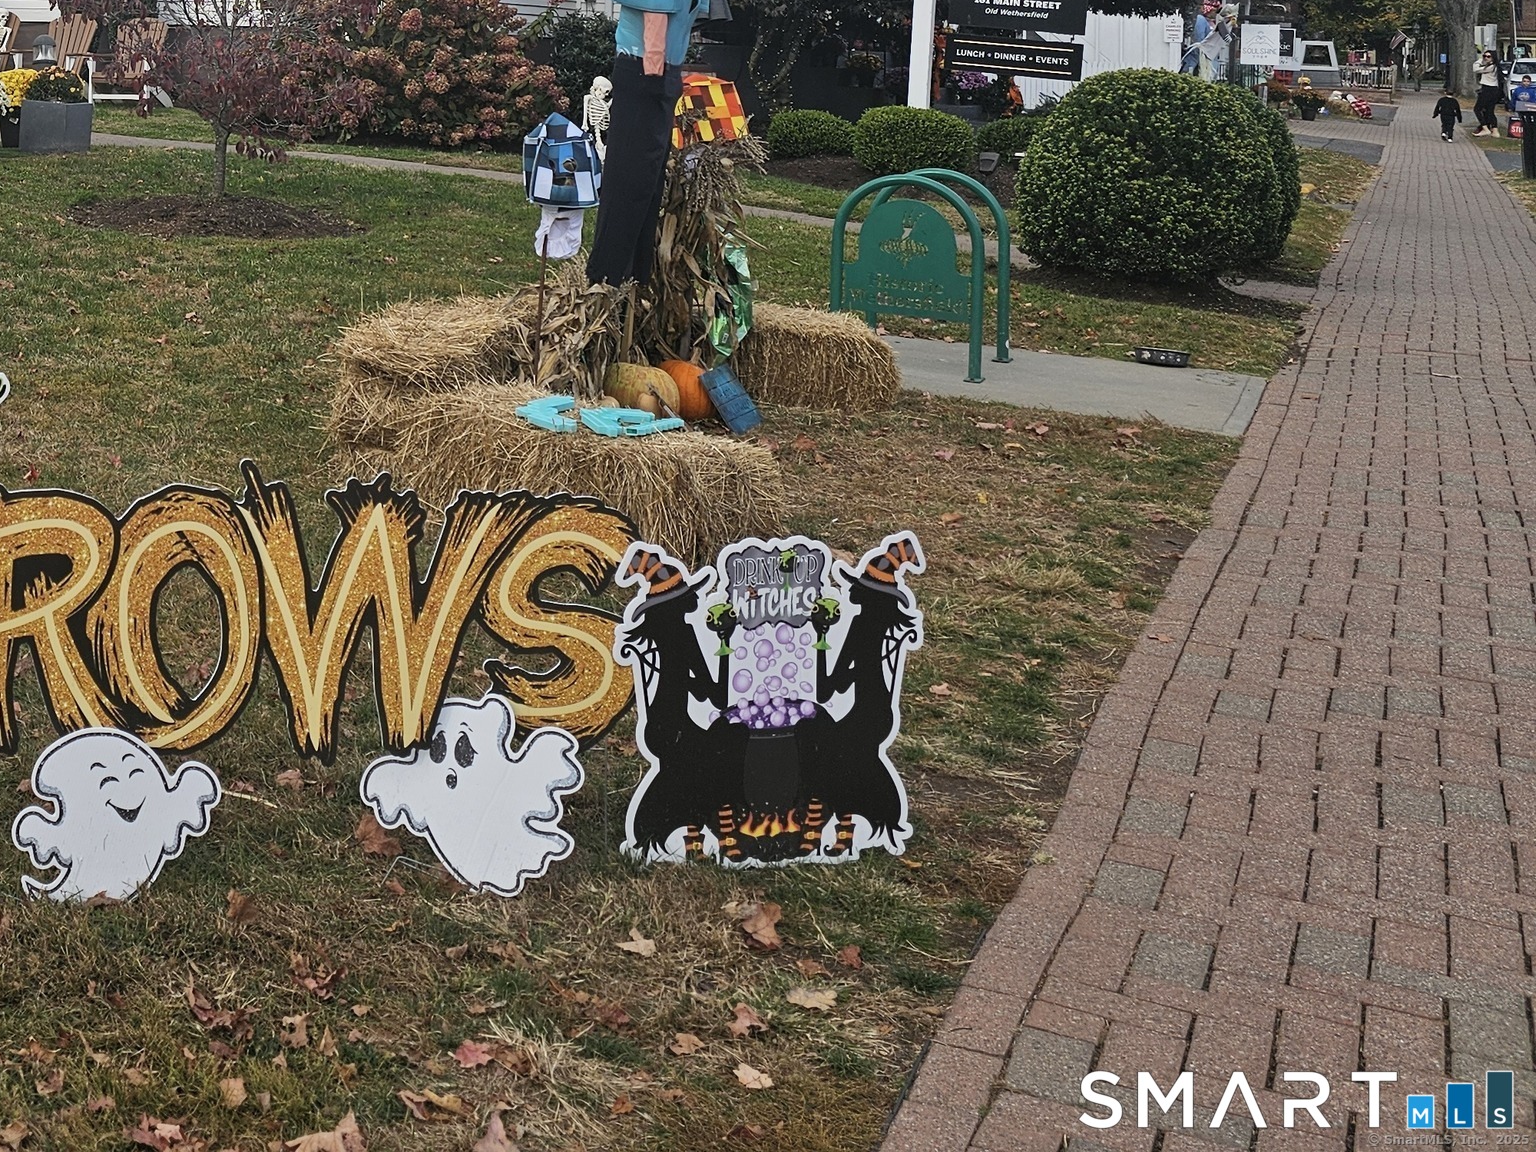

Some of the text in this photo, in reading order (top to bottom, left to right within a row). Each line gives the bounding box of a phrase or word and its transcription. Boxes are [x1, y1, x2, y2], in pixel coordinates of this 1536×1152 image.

[985, 7, 1049, 19] Old Wethersfield
[1023, 0, 1062, 9] STREET
[956, 49, 1069, 66] LUNCH DINNER EVENTS
[868, 272, 944, 294] Historic
[733, 554, 818, 587] DRINK UP
